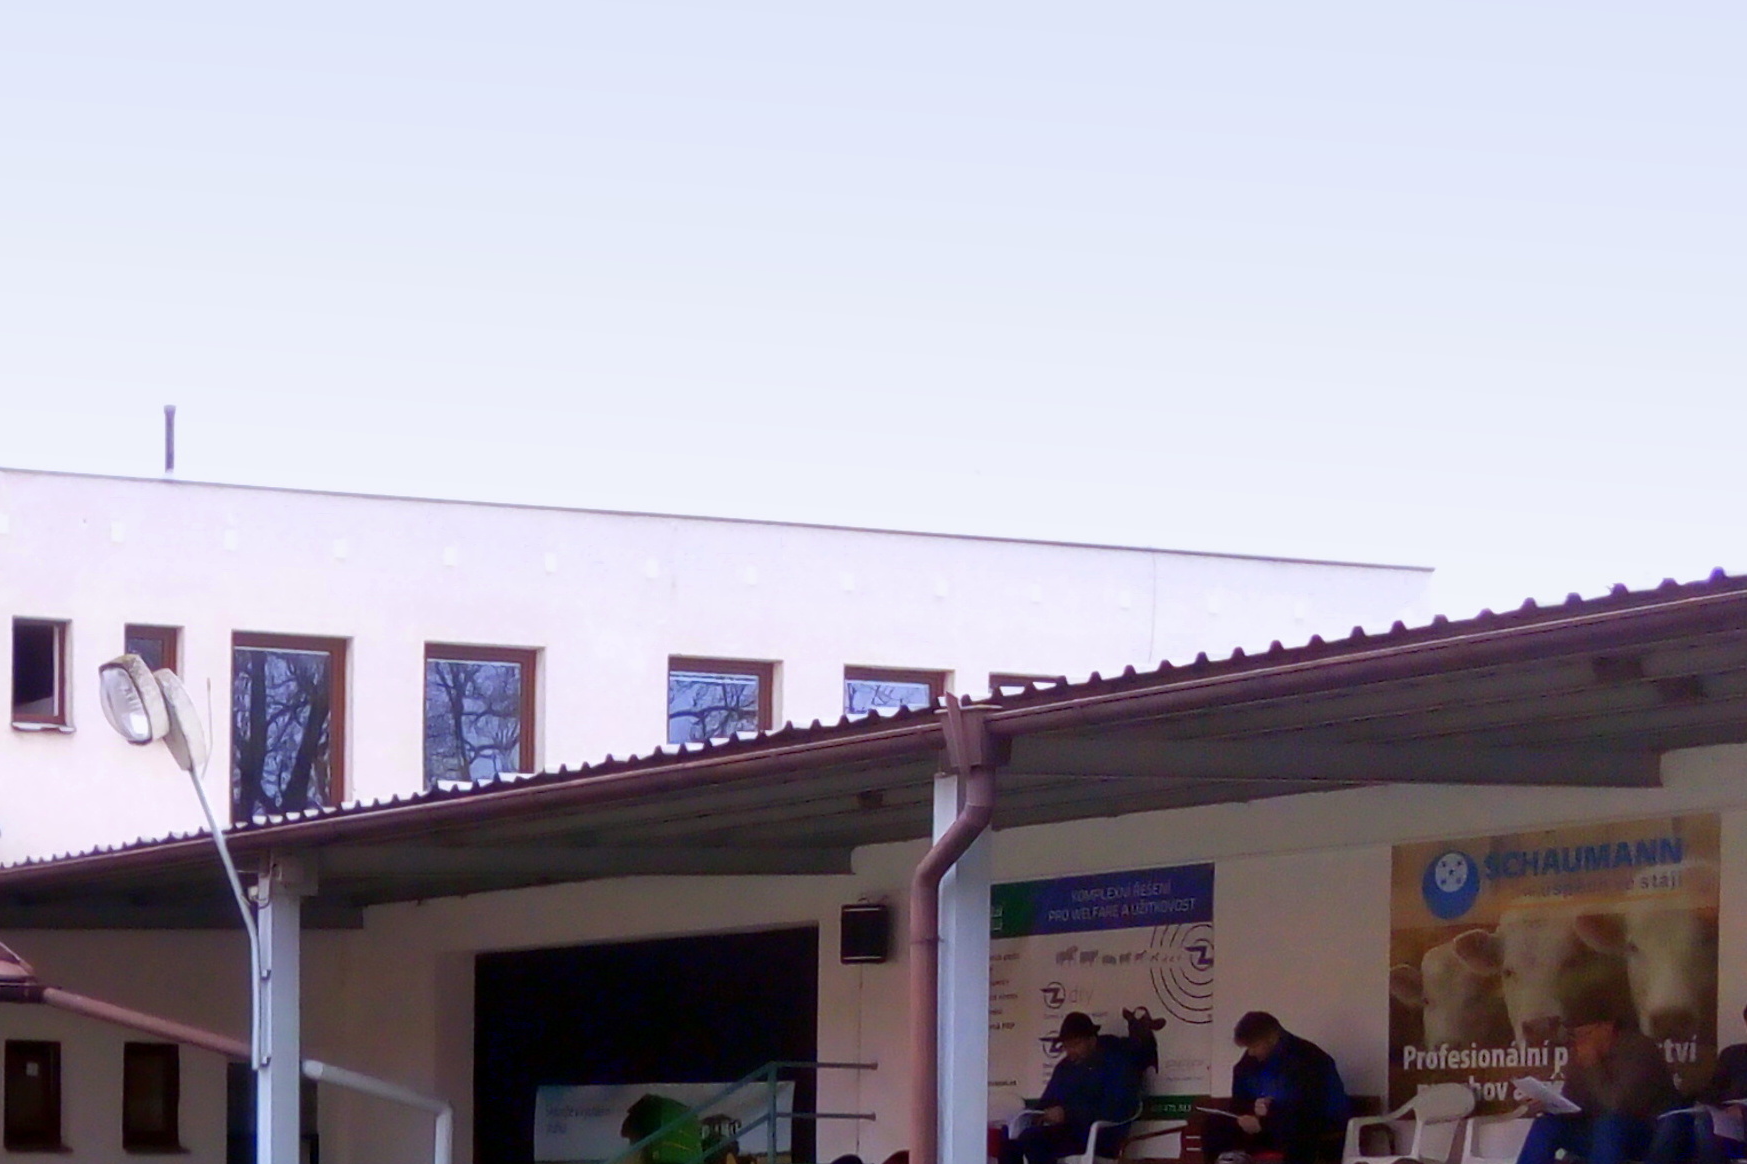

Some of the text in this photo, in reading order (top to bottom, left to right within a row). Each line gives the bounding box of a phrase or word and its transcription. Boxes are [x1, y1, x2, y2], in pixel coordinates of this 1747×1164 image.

[1483, 836, 1684, 881] SCHAUMANN
[1071, 904, 1119, 920] WELFARE
[1121, 905, 1130, 917] A
[1403, 1040, 1550, 1070] Profesionální
